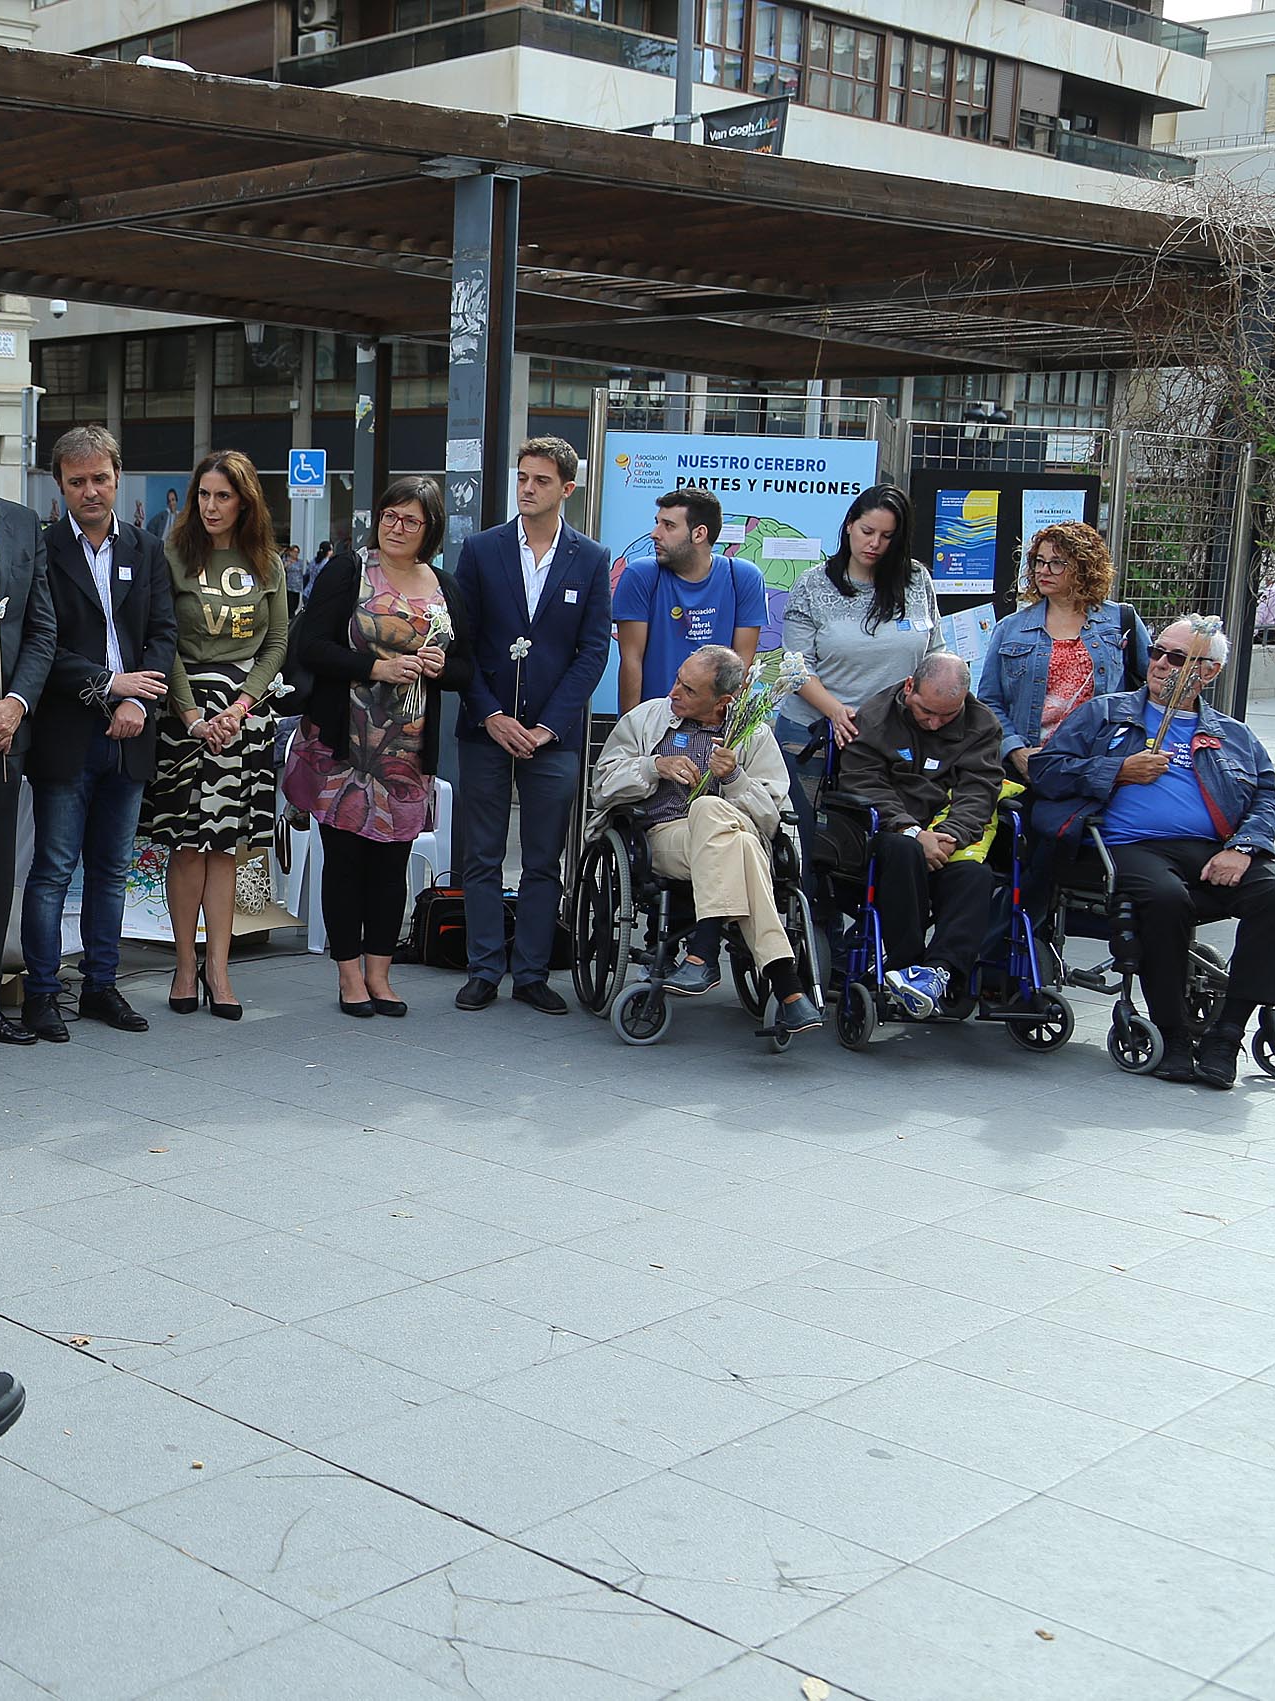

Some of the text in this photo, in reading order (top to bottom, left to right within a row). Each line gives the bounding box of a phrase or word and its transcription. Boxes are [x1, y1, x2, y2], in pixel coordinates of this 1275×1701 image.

[710, 130, 727, 141] Van
[728, 122, 754, 136] Gogh
[677, 454, 826, 472] NUESTRO CEREBRO
[676, 476, 861, 495] PARTES Y FUNCIONES
[197, 566, 254, 598] LO
[203, 604, 255, 639] VE
